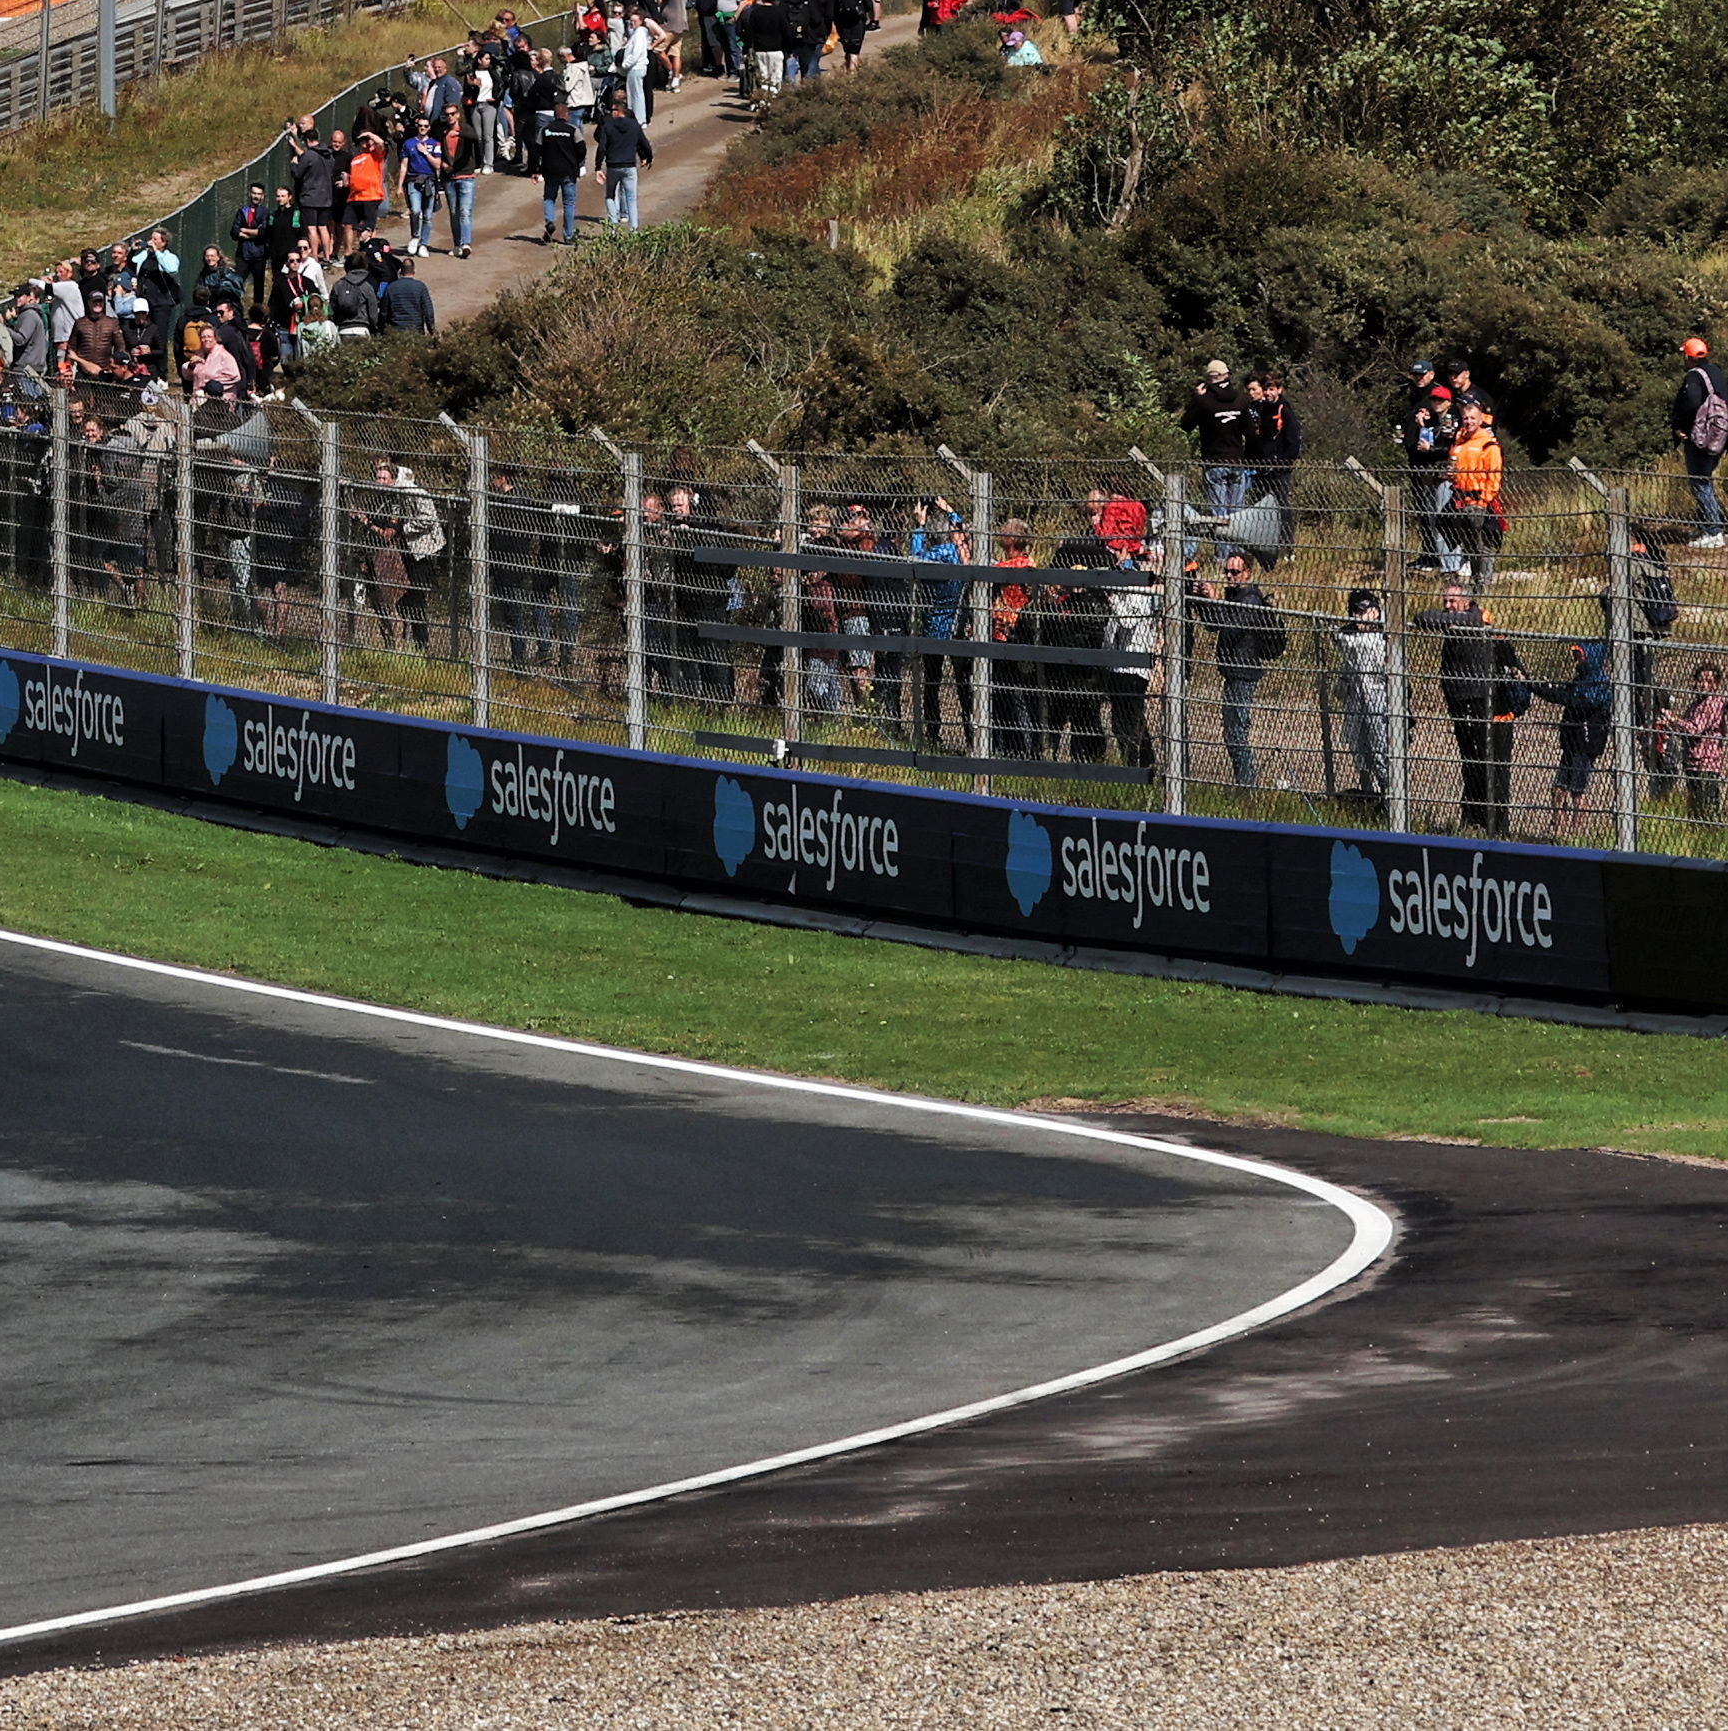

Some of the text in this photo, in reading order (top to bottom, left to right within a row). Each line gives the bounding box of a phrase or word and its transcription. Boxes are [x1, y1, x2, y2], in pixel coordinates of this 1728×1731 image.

[24, 663, 124, 757] salesforce
[243, 708, 357, 803] salesforce
[490, 748, 618, 846] salesforce
[762, 786, 900, 892] salesforce
[1060, 820, 1212, 929] salesforce
[1387, 850, 1554, 968] salesforce
